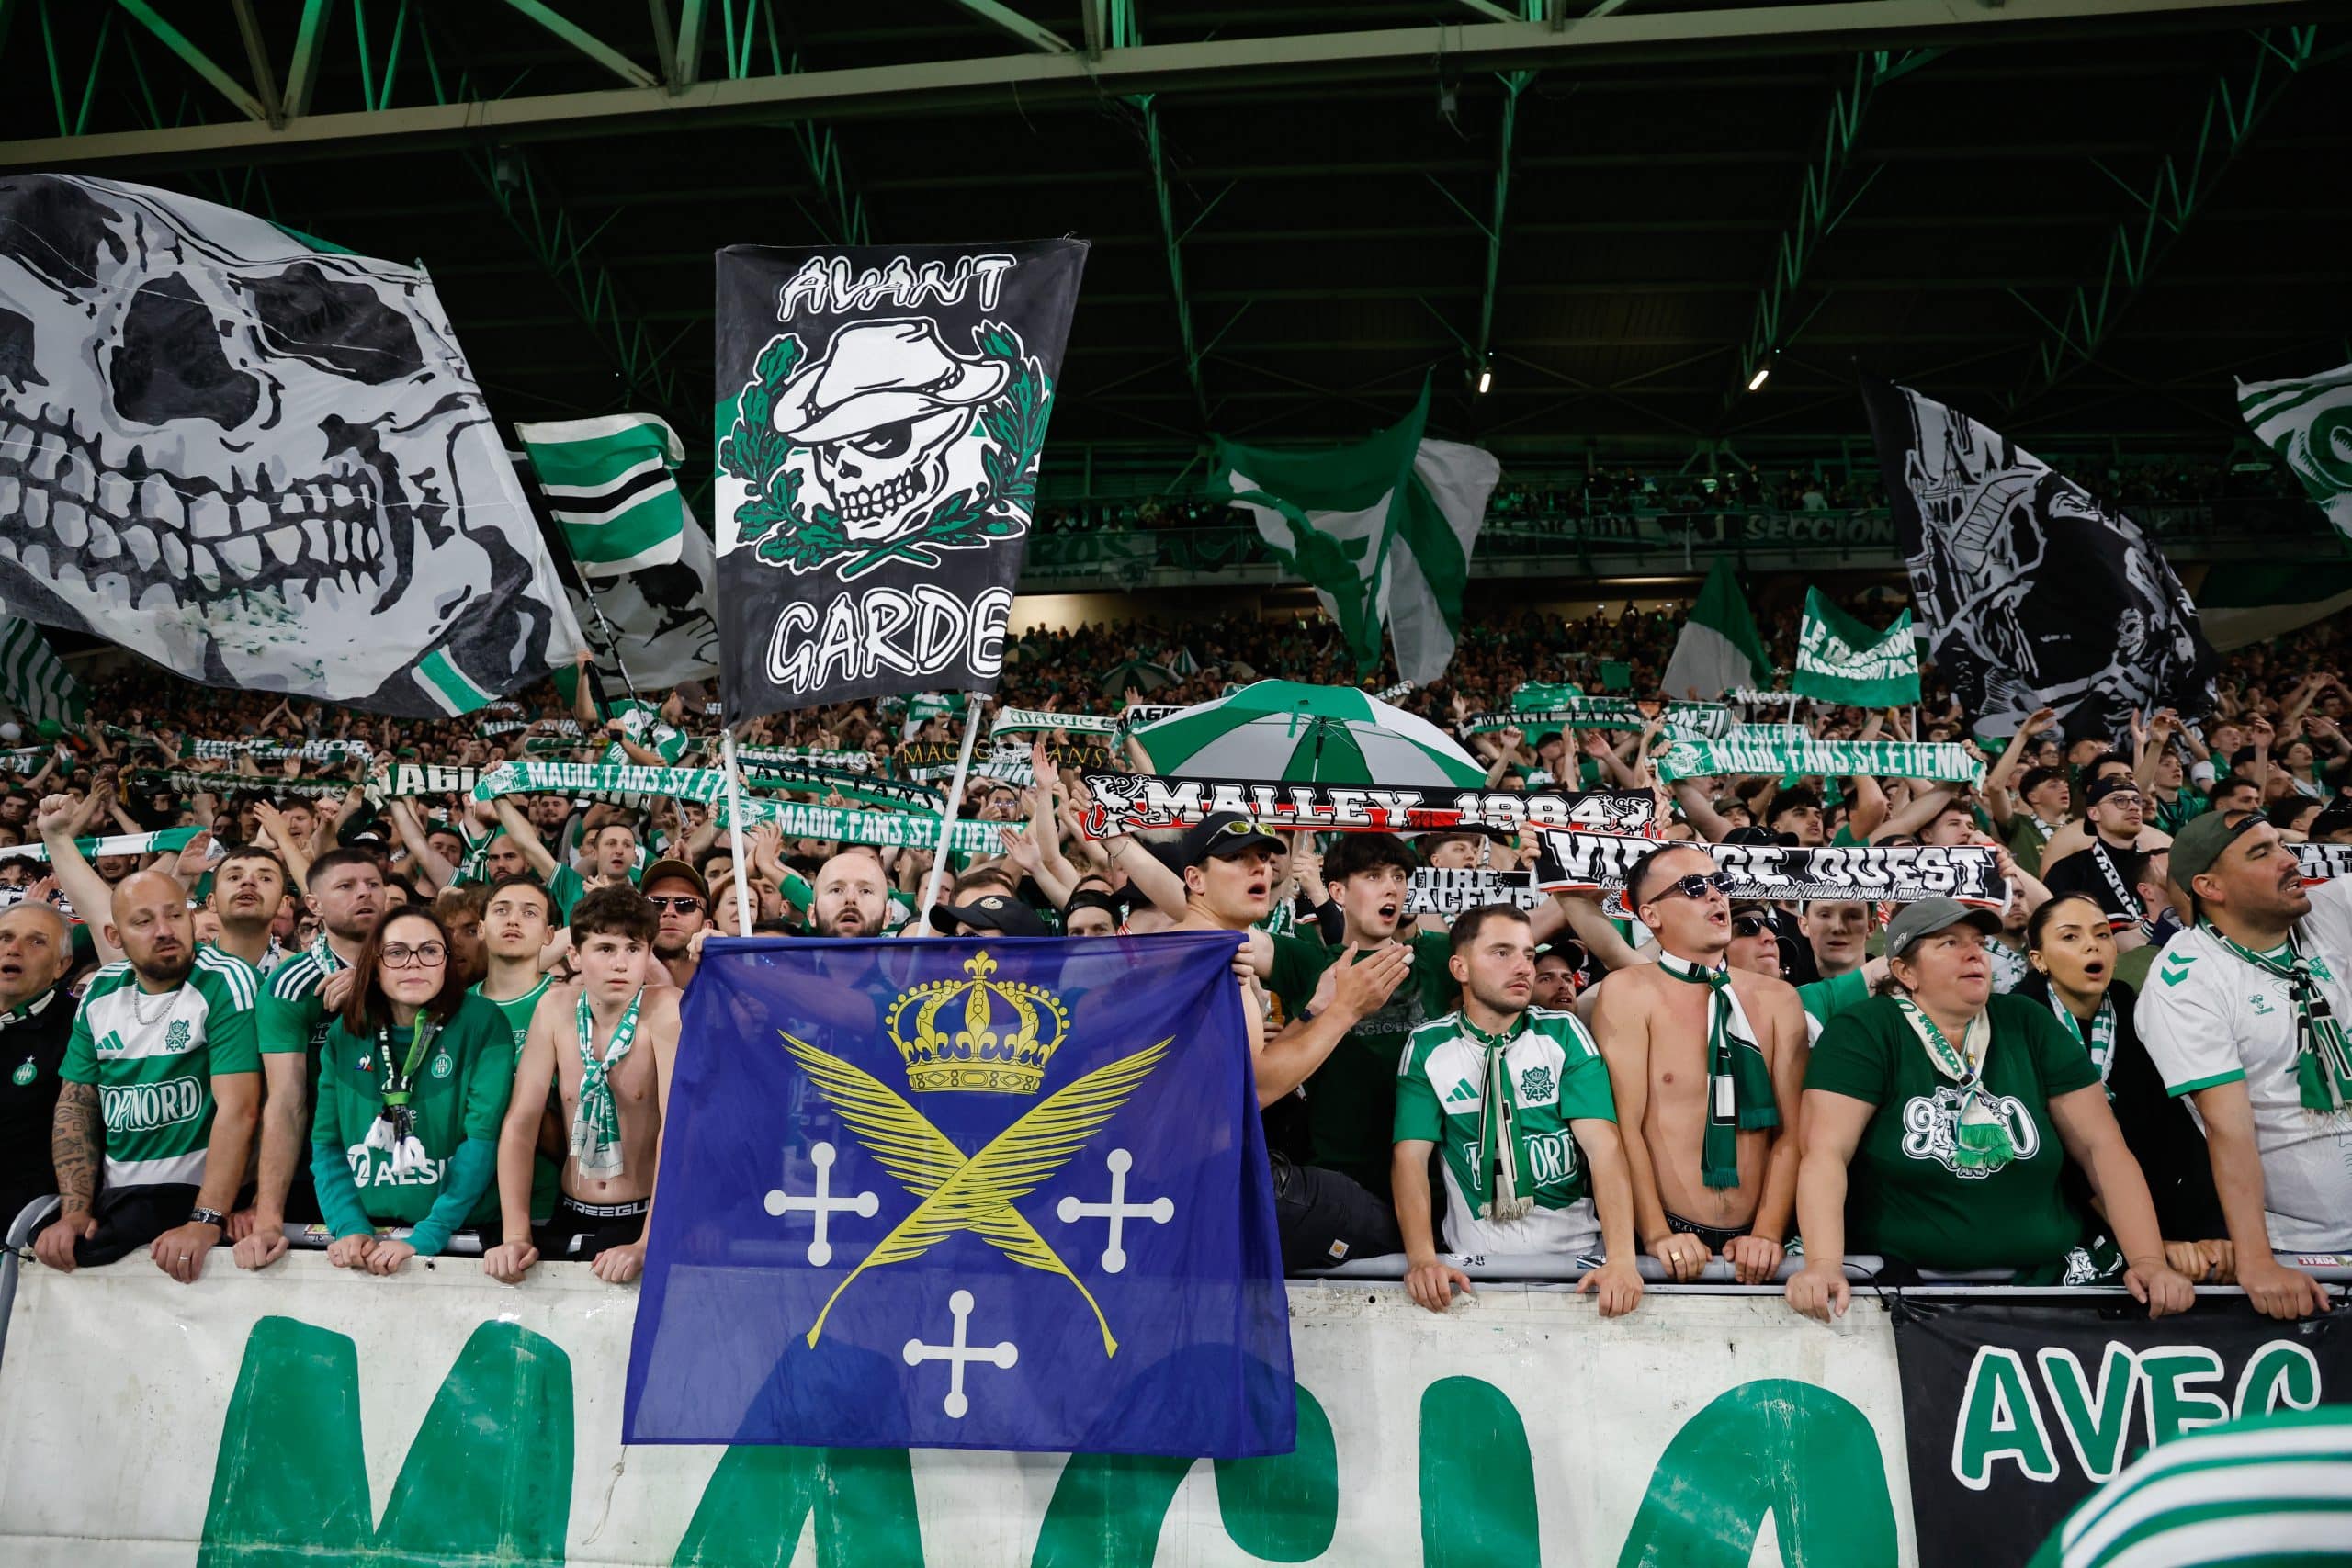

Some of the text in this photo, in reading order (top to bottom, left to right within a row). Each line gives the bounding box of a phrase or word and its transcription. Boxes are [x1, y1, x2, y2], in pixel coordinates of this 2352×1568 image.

[777, 254, 1016, 321] AVANT
[766, 583, 1012, 694] GARDE
[1481, 711, 1631, 728] MAGIC FANS
[903, 741, 1102, 765] MAGC ANS
[1712, 741, 1974, 781] MAGIC FANS ST.ETIENN
[526, 761, 598, 788] MAGIC
[604, 764, 659, 793] FANS
[775, 804, 843, 840] MAGIC
[849, 811, 905, 844] FANS
[1145, 779, 1423, 829] MALLEY
[1810, 846, 1997, 898] OUEST
[563, 1197, 650, 1217] FREEGU
